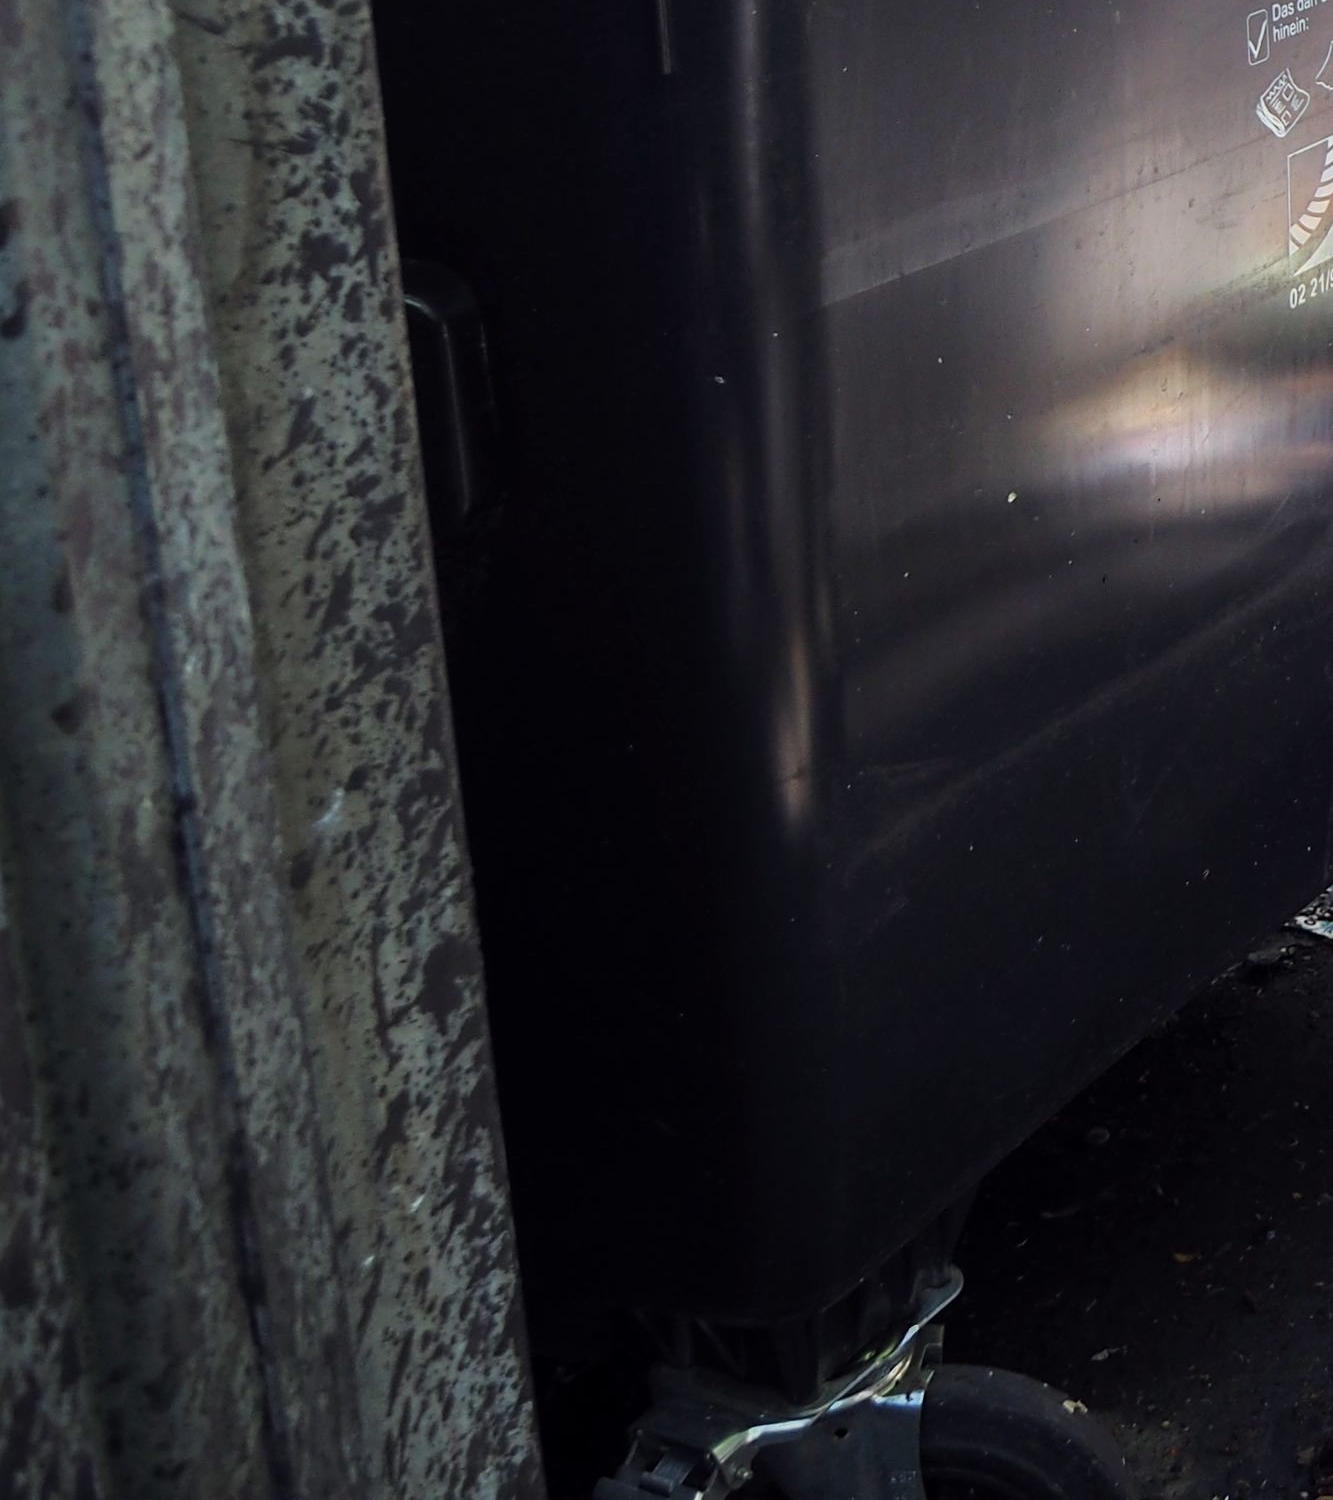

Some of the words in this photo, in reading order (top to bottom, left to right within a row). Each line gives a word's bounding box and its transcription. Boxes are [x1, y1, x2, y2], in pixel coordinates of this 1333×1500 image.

[1272, 0, 1295, 22] Das
[1273, 16, 1310, 42] hinein:
[1289, 284, 1306, 308] 02
